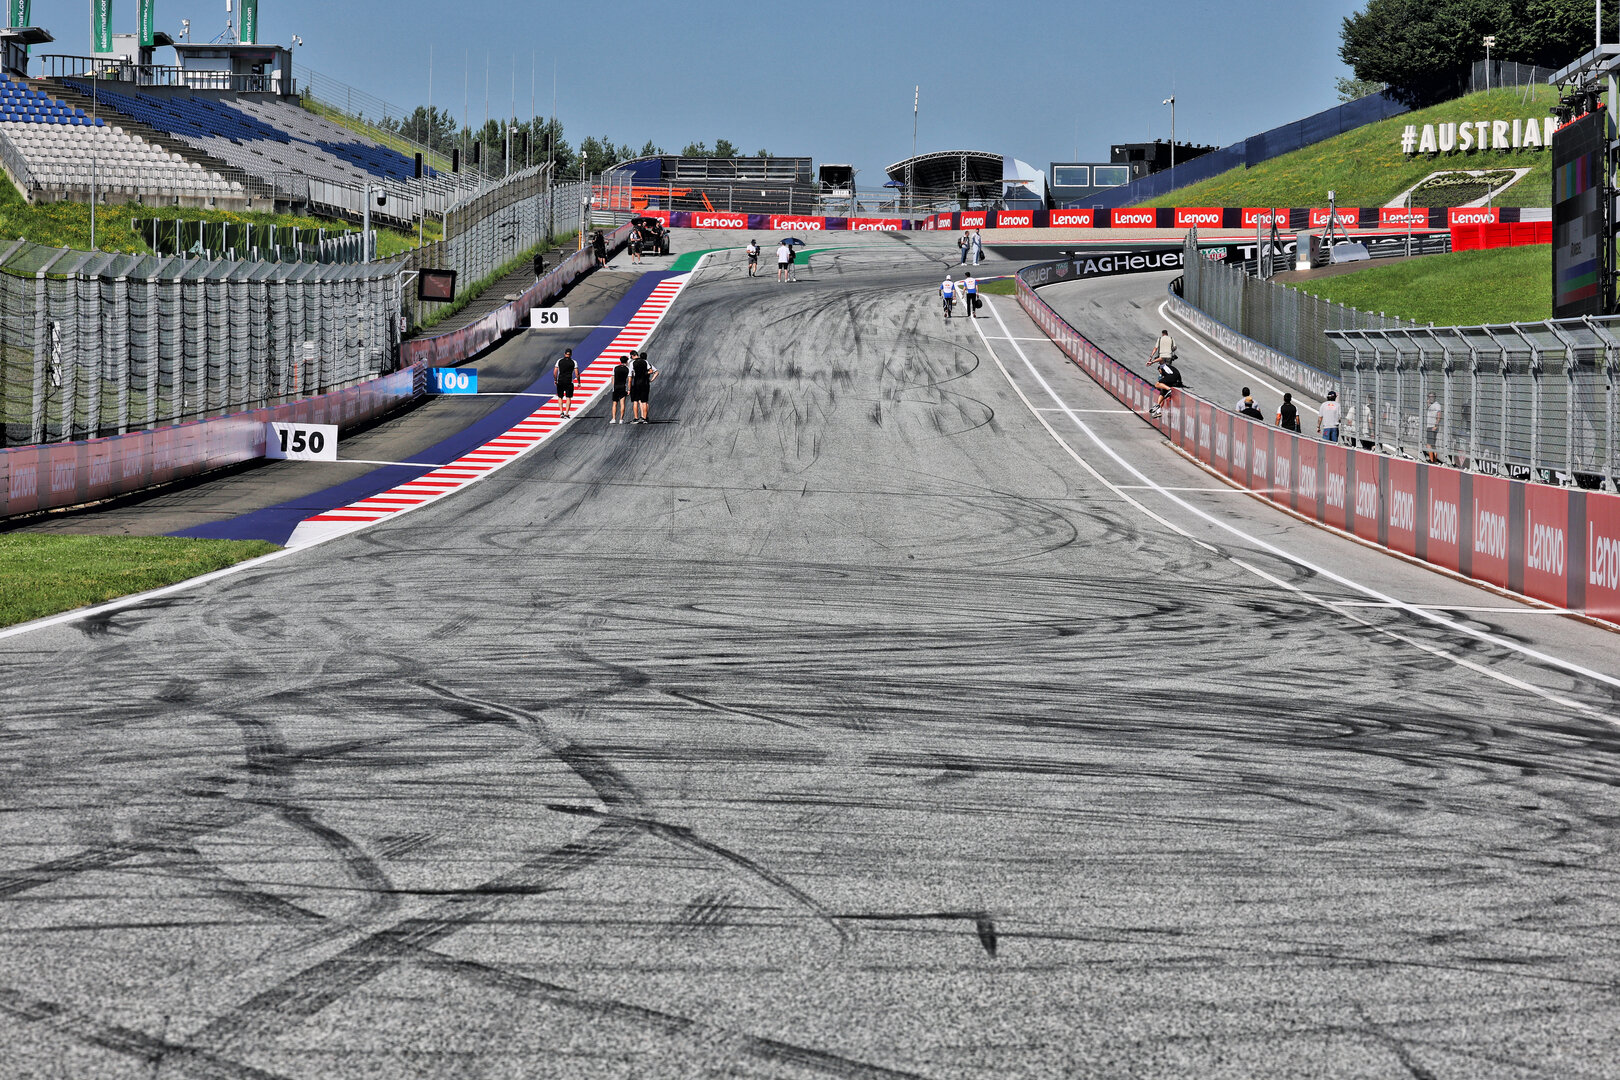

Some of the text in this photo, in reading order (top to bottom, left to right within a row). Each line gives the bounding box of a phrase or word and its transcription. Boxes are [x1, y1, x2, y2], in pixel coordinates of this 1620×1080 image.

[696, 216, 744, 228] Lenovo
[961, 216, 984, 227] Lenovo
[999, 214, 1030, 226] Lenovo
[1052, 213, 1090, 225] Lenovo
[1114, 213, 1153, 224] Lenovo
[1178, 212, 1219, 224] Lenovo
[1451, 212, 1495, 224] Lenovo
[773, 220, 820, 230] Lenovo
[851, 221, 897, 231] Lenovo
[541, 311, 558, 324] 50
[436, 373, 469, 389] 100
[279, 429, 324, 453] 150
[1326, 462, 1345, 510] Lenovo
[1355, 470, 1377, 519] Lenovo
[1390, 479, 1414, 532] Lenovo
[1429, 487, 1457, 545] Lenovo
[1475, 498, 1506, 560] Lenovo
[1527, 509, 1564, 576] Lenovo
[1589, 520, 1620, 591] Leno
